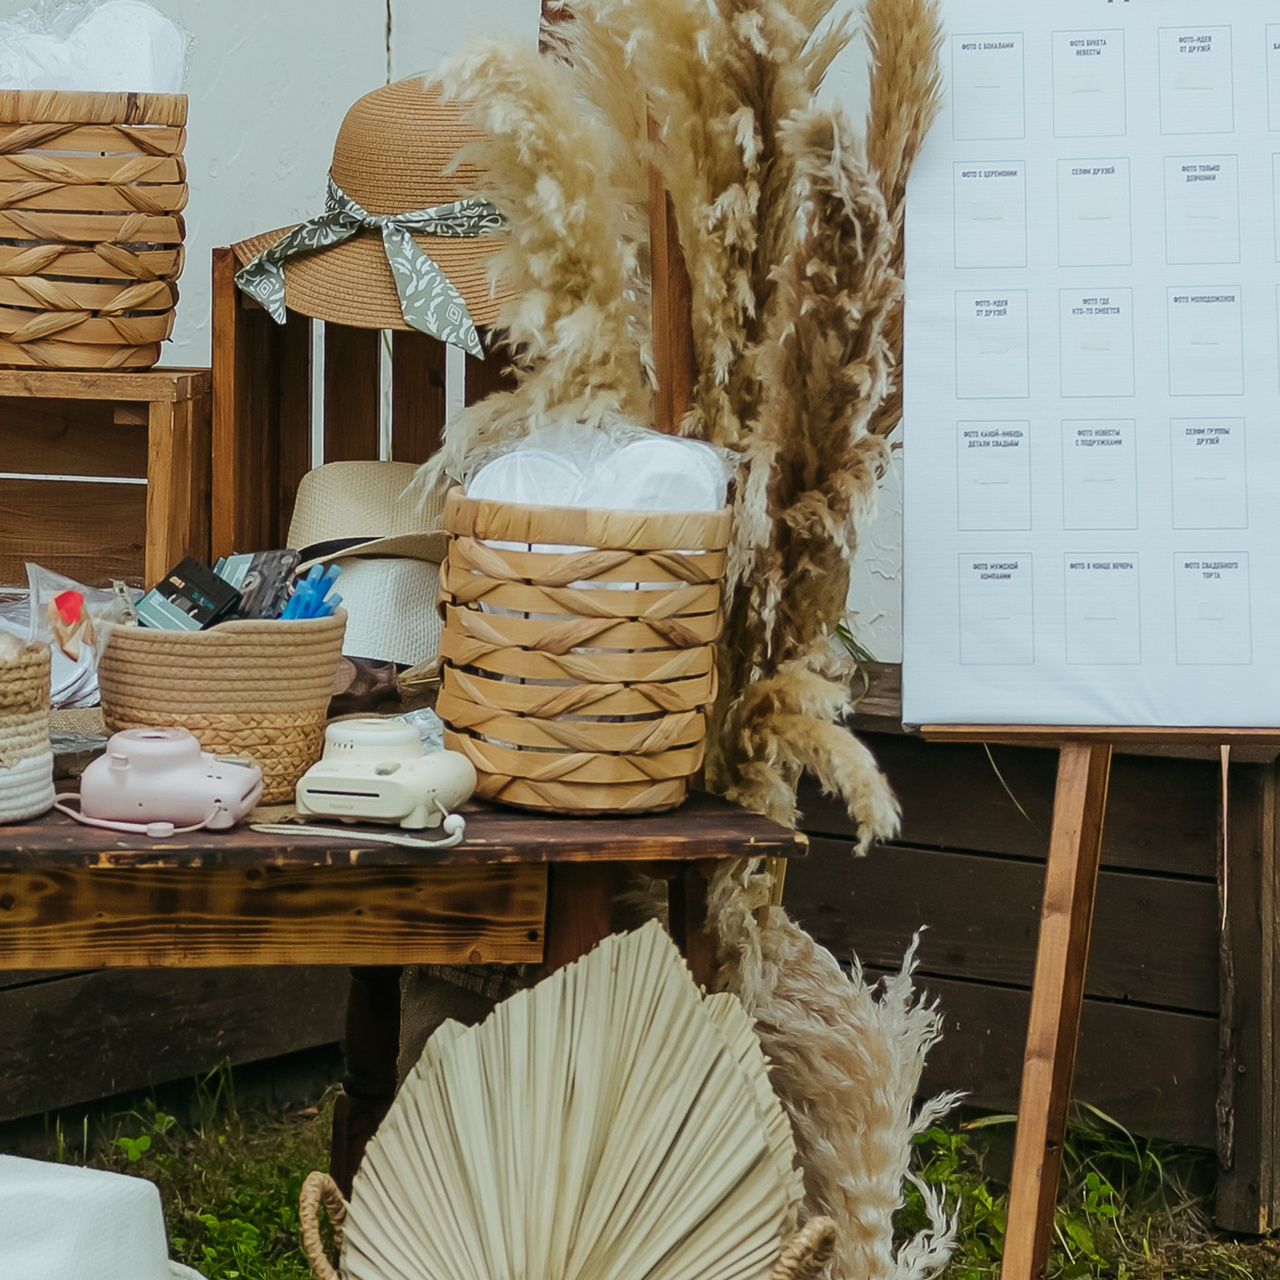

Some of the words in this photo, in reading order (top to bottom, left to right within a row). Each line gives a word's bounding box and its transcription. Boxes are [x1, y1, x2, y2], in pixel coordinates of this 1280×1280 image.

[1069, 39, 1086, 47] ФОТО
[1086, 38, 1108, 47] БУКЕТА
[1178, 35, 1212, 44] ФОТО-ИДЕЯ
[961, 42, 977, 51] ФОТО
[983, 41, 1015, 51] БОКАЛАМИ
[1179, 45, 1187, 54] ОТ
[1187, 43, 1211, 54] ДРУЗЕЙ
[1075, 48, 1102, 57] НЕВЕСТЫ
[1091, 165, 1116, 176] ДРУЗЕЙ
[1181, 164, 1198, 173] ФОТО
[961, 170, 978, 179] ФОТО
[974, 299, 1009, 308] ФОТО-ИДЕЯ
[1082, 297, 1099, 306] ФОТО
[1098, 297, 1110, 306] ГДЕ
[1173, 295, 1190, 304] ФОТО
[975, 309, 984, 317] ОТ
[983, 307, 1008, 318] ДРУЗЕЙ
[1071, 307, 1094, 316] КТО-ТО
[963, 430, 979, 439] ФОТО
[1076, 429, 1094, 437] ФОТО
[1094, 428, 1121, 437] НЕВЕСТЫ
[967, 440, 991, 449] ДЕТАЛИ
[1195, 435, 1220, 446] ДРУЗЕЙ
[972, 562, 989, 571] ФОТО
[1069, 562, 1086, 570] ФОТО
[1112, 562, 1134, 570] ВЕЧЕРА
[1184, 561, 1200, 570] ФОТО
[1202, 571, 1221, 580] ТОРТА
